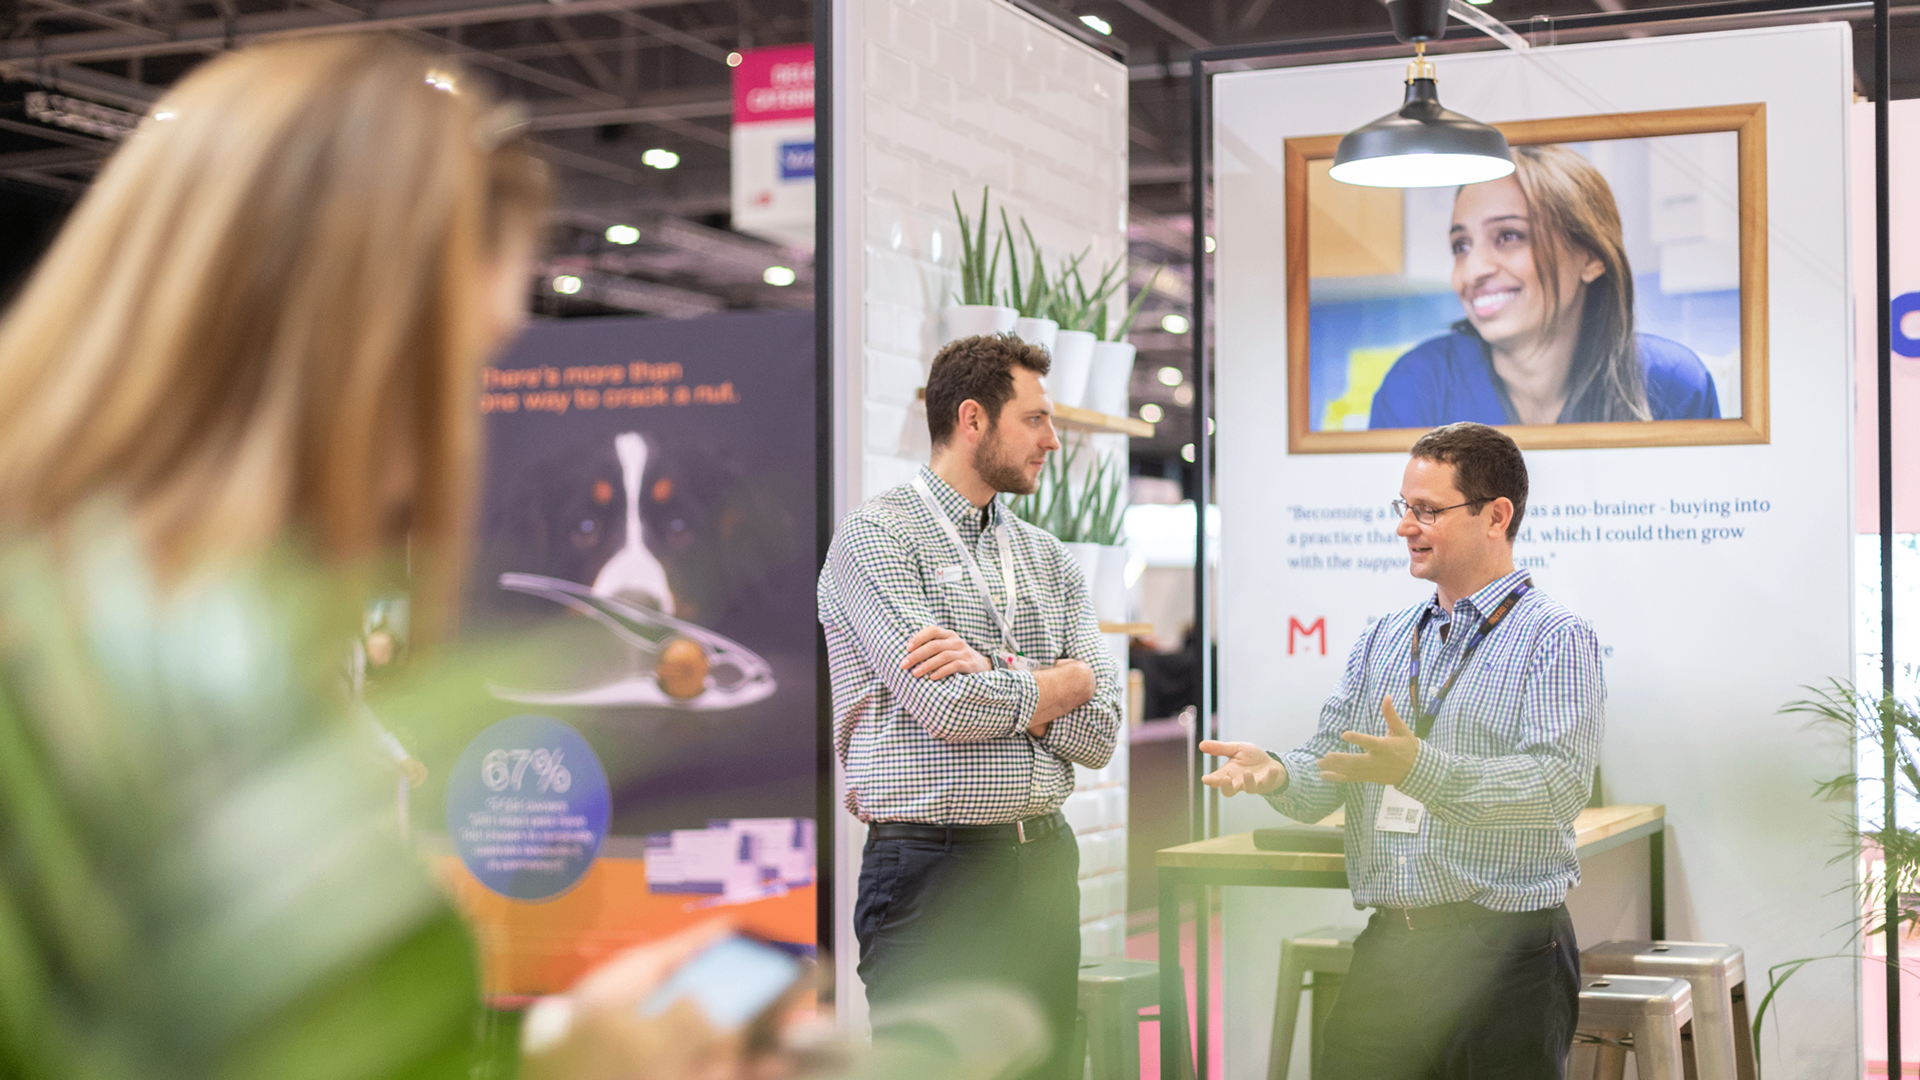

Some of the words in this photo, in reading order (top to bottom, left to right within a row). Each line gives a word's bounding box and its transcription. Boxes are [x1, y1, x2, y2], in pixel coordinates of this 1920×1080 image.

[563, 365, 627, 386] more
[628, 360, 683, 383] than
[522, 391, 571, 414] way
[574, 389, 600, 409] to
[602, 386, 669, 408] crack
[672, 385, 692, 406] a
[693, 381, 741, 405] nut.
[1287, 504, 1374, 523] "Becoming
[1377, 507, 1386, 520] a
[1552, 504, 1561, 516] a
[1565, 499, 1655, 516] no-brainer
[1670, 498, 1731, 519] buying
[1735, 497, 1771, 513] into
[1287, 532, 1297, 544] a
[1299, 529, 1363, 549] practice
[1366, 529, 1399, 544] that
[1541, 525, 1592, 542] which
[1596, 526, 1602, 540] I
[1605, 524, 1653, 541] could
[1657, 524, 1697, 541] then
[1701, 526, 1746, 545] grow
[1287, 553, 1324, 569] with
[1326, 553, 1351, 568] the
[1357, 557, 1409, 574] suppor
[1287, 616, 1327, 656] M
[482, 747, 572, 793] 67%
